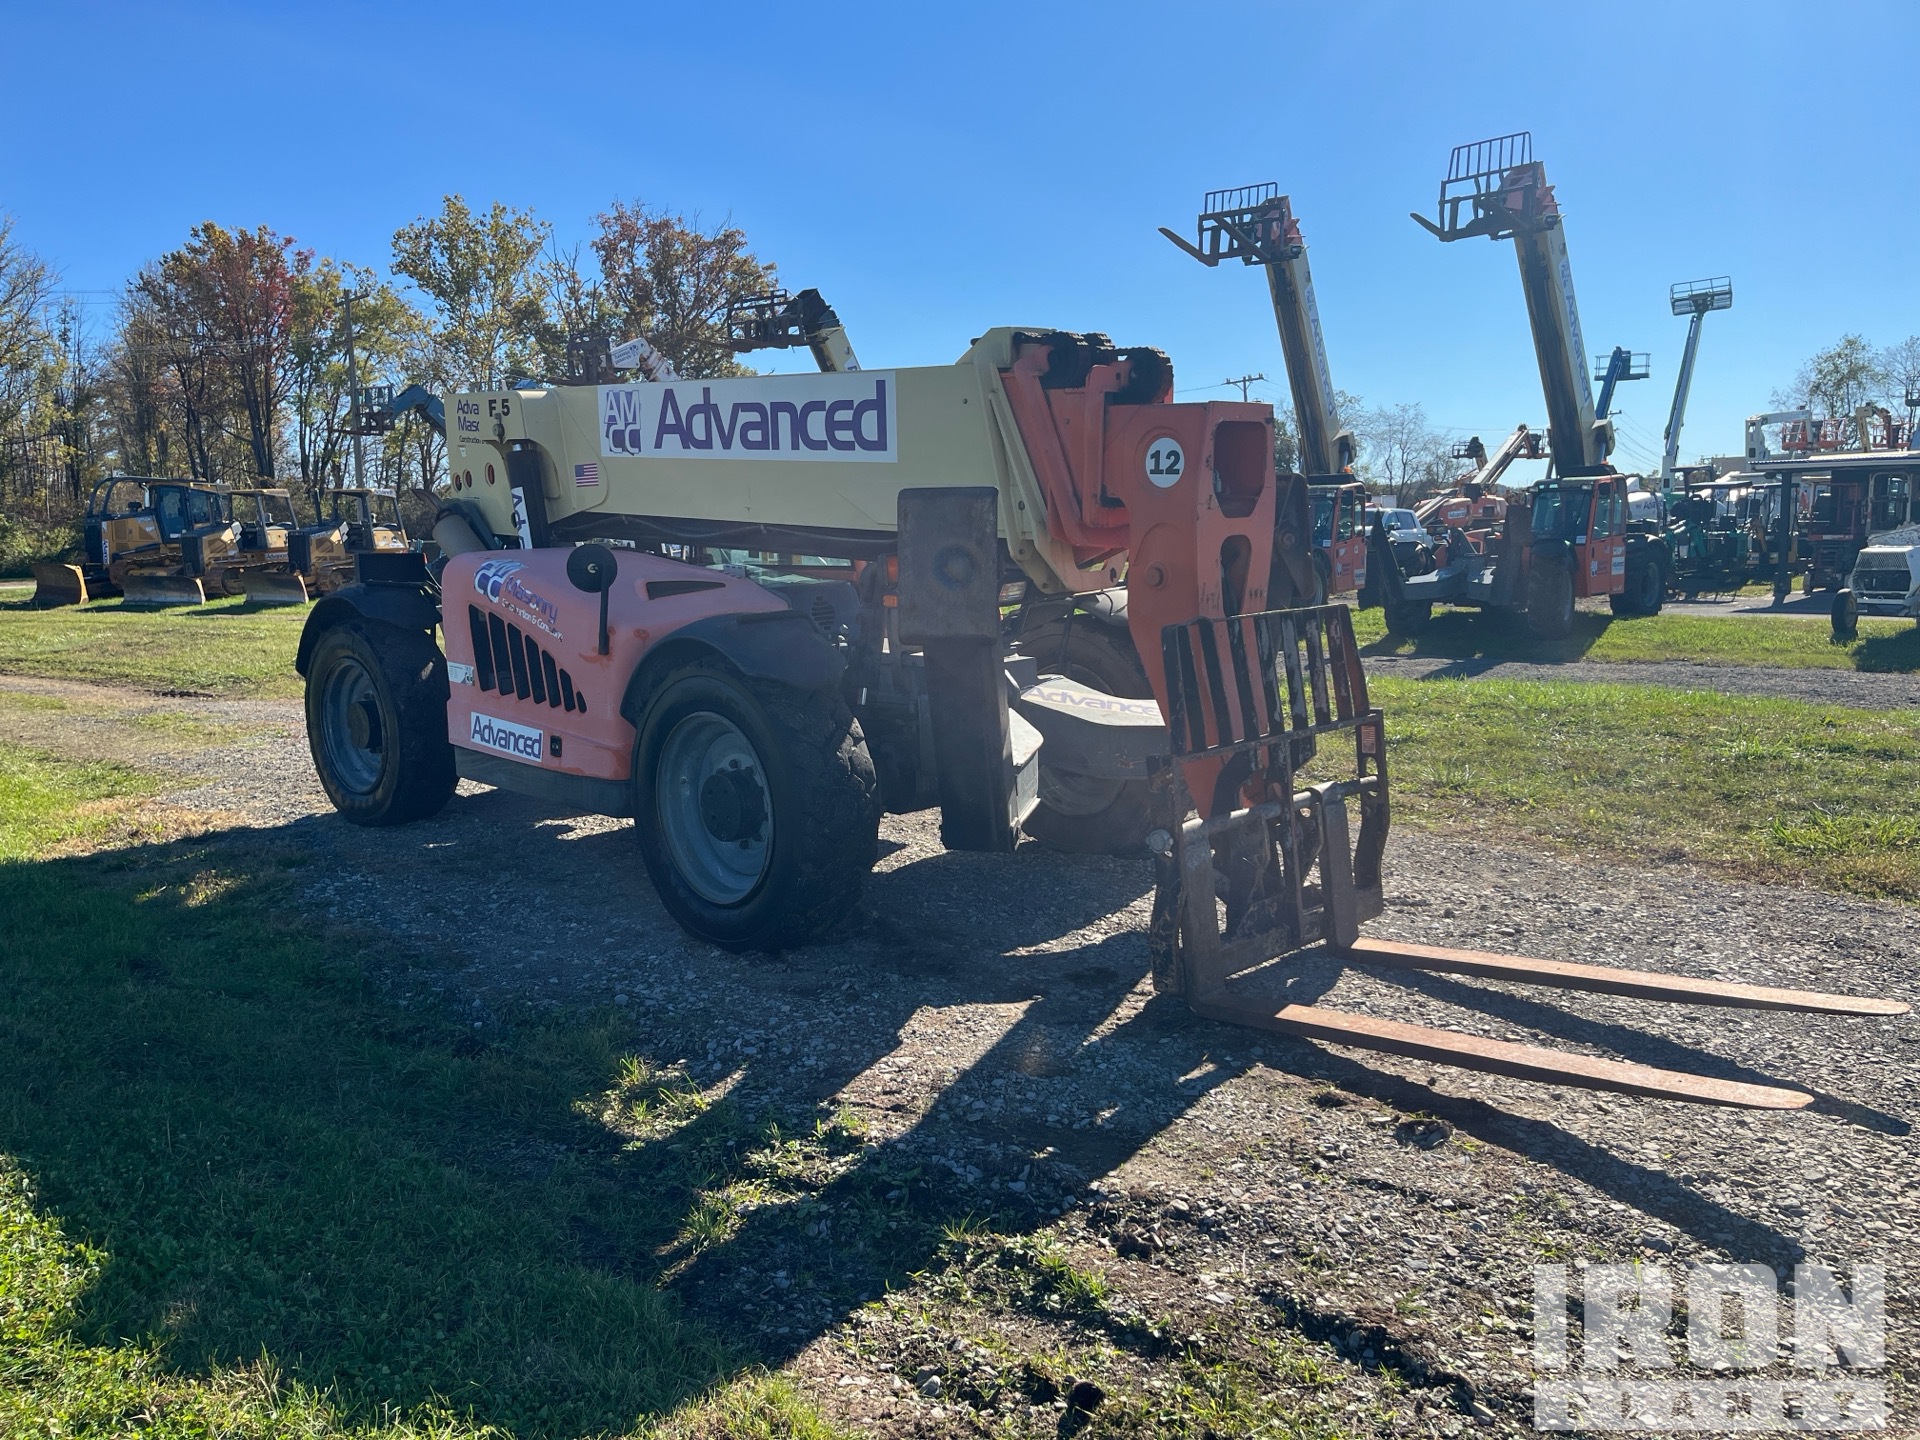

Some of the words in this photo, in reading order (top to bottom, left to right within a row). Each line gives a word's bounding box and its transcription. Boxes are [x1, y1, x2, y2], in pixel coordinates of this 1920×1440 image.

[1566, 294, 1592, 403] Advanced
[654, 379, 887, 451] Advanced
[1149, 449, 1181, 475] 12
[505, 576, 559, 625] Masonry
[1022, 687, 1160, 717] Advance
[472, 715, 543, 759] Advanced
